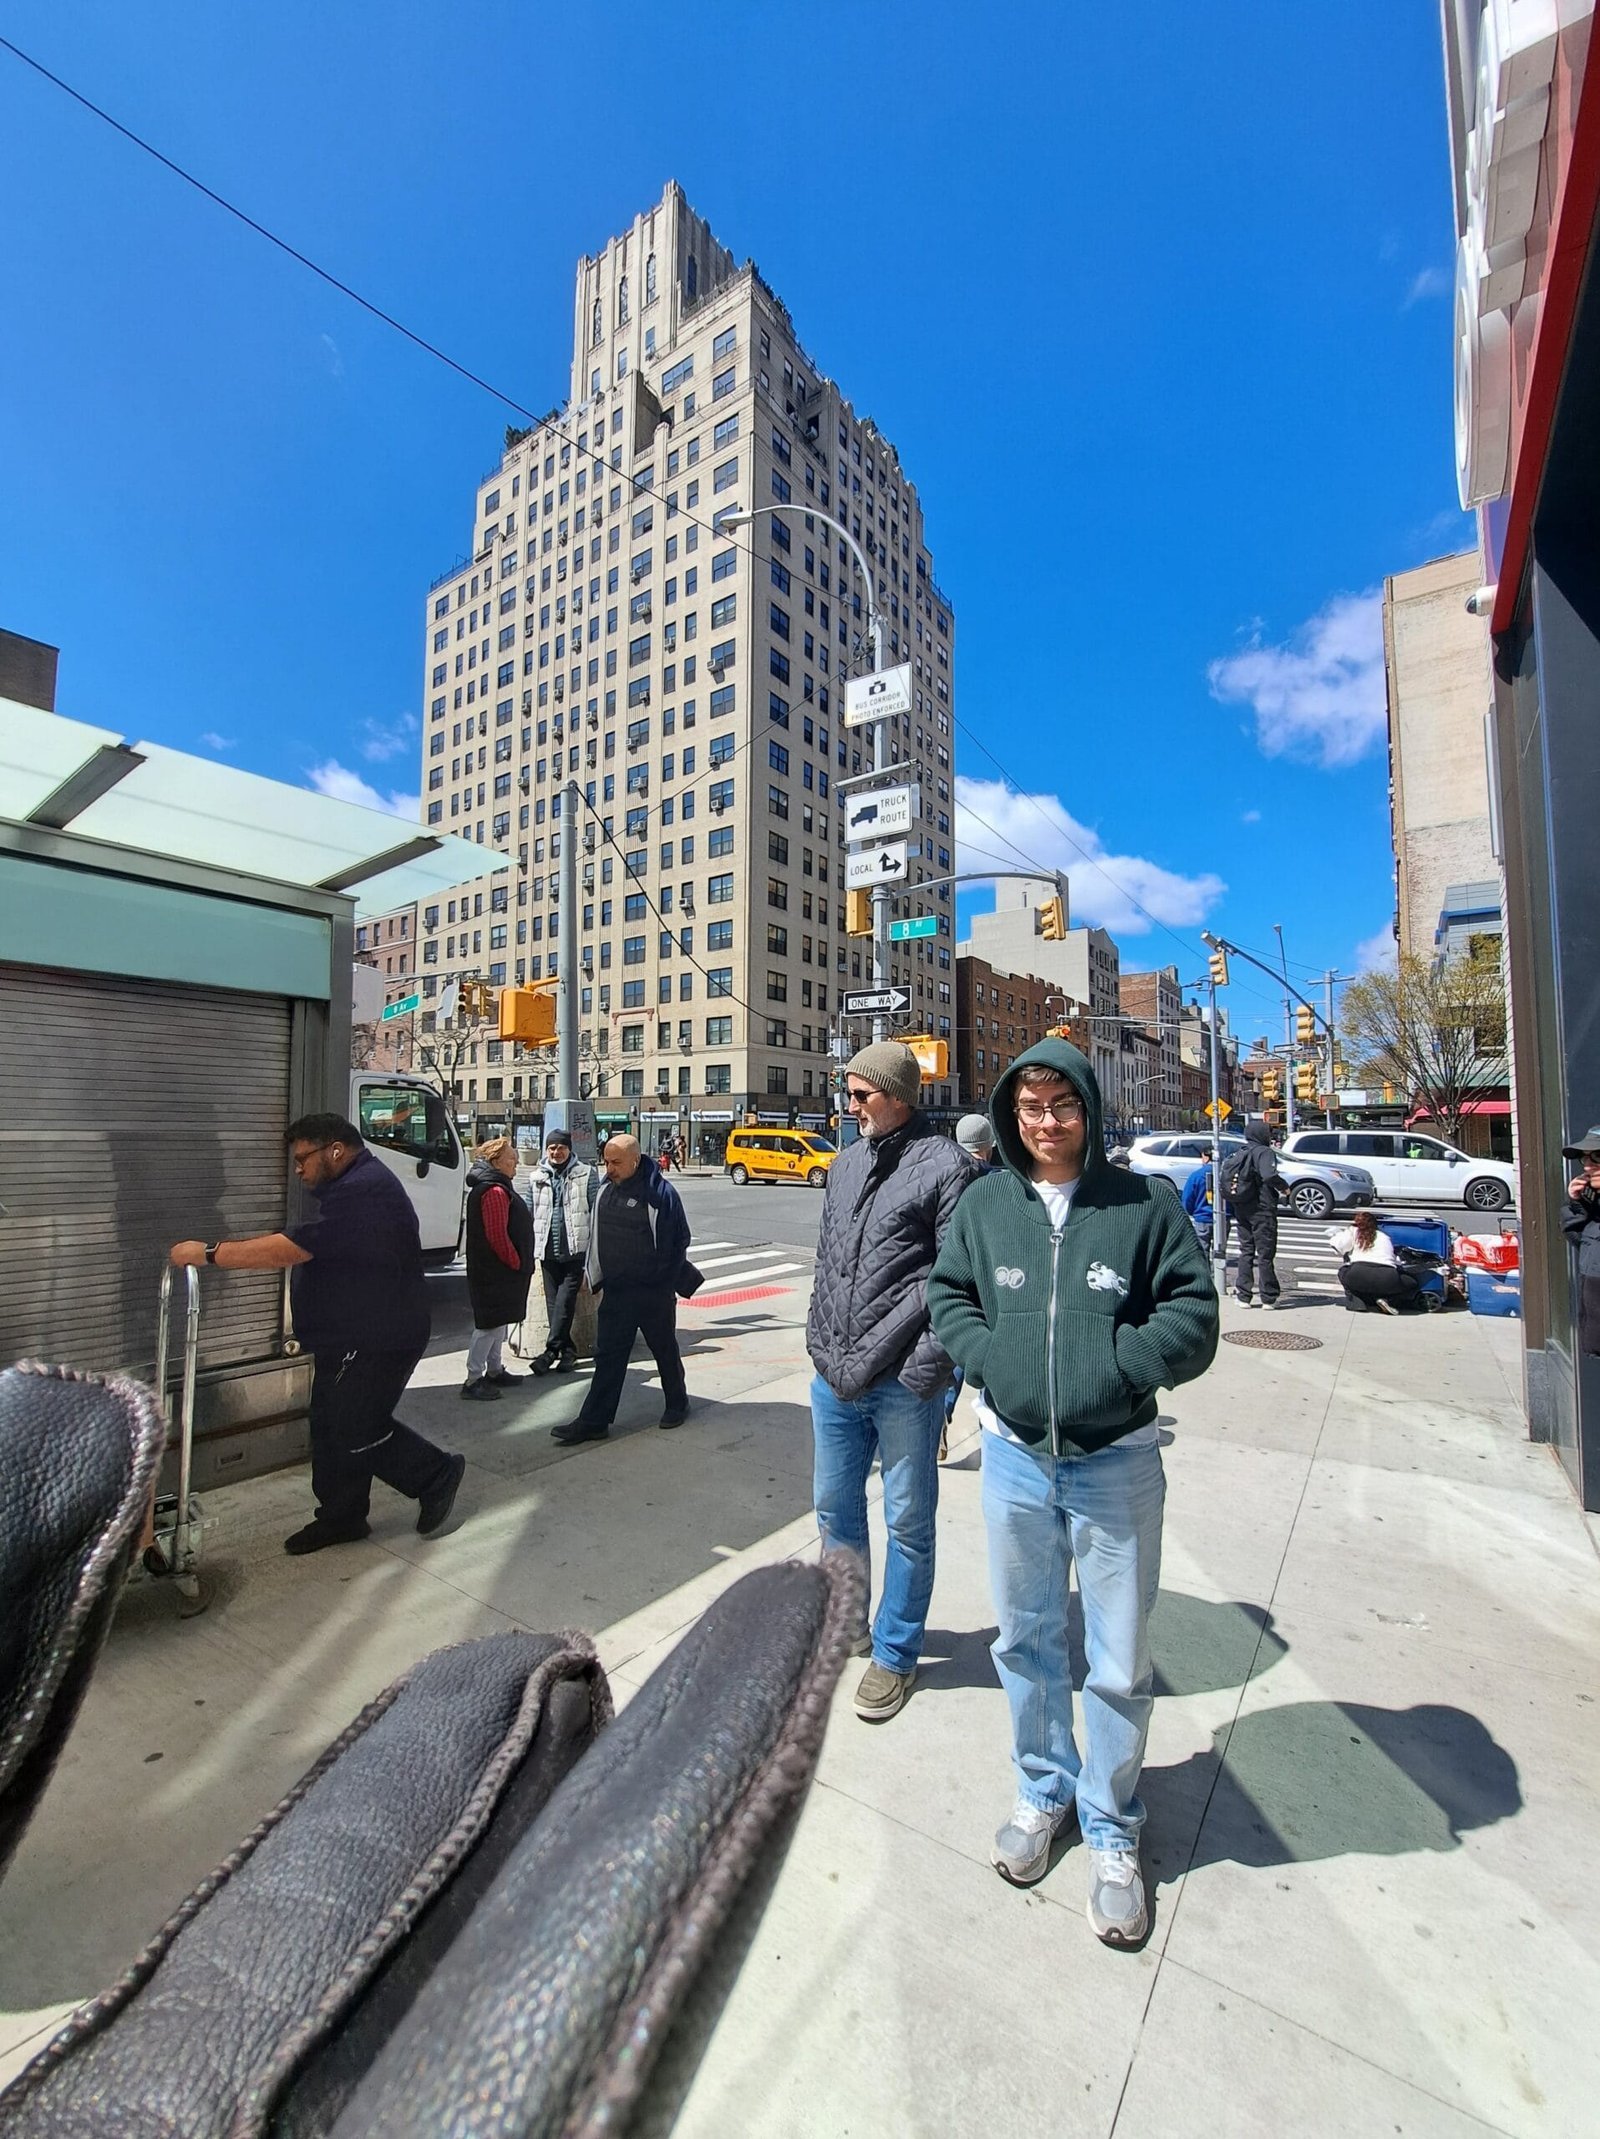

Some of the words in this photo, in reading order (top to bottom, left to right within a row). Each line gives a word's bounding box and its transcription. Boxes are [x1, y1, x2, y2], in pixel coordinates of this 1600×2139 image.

[855, 701, 868, 711] BUS
[869, 692, 901, 706] CORRIDOR
[851, 711, 871, 721] PHOTO
[872, 701, 906, 716] ENFORCED
[880, 794, 907, 808] TRUCK
[880, 811, 907, 824] ROUTE
[850, 865, 873, 876] LOCAL
[902, 922, 910, 937] 8
[851, 997, 869, 1009] ONE
[878, 995, 898, 1006] WAY
